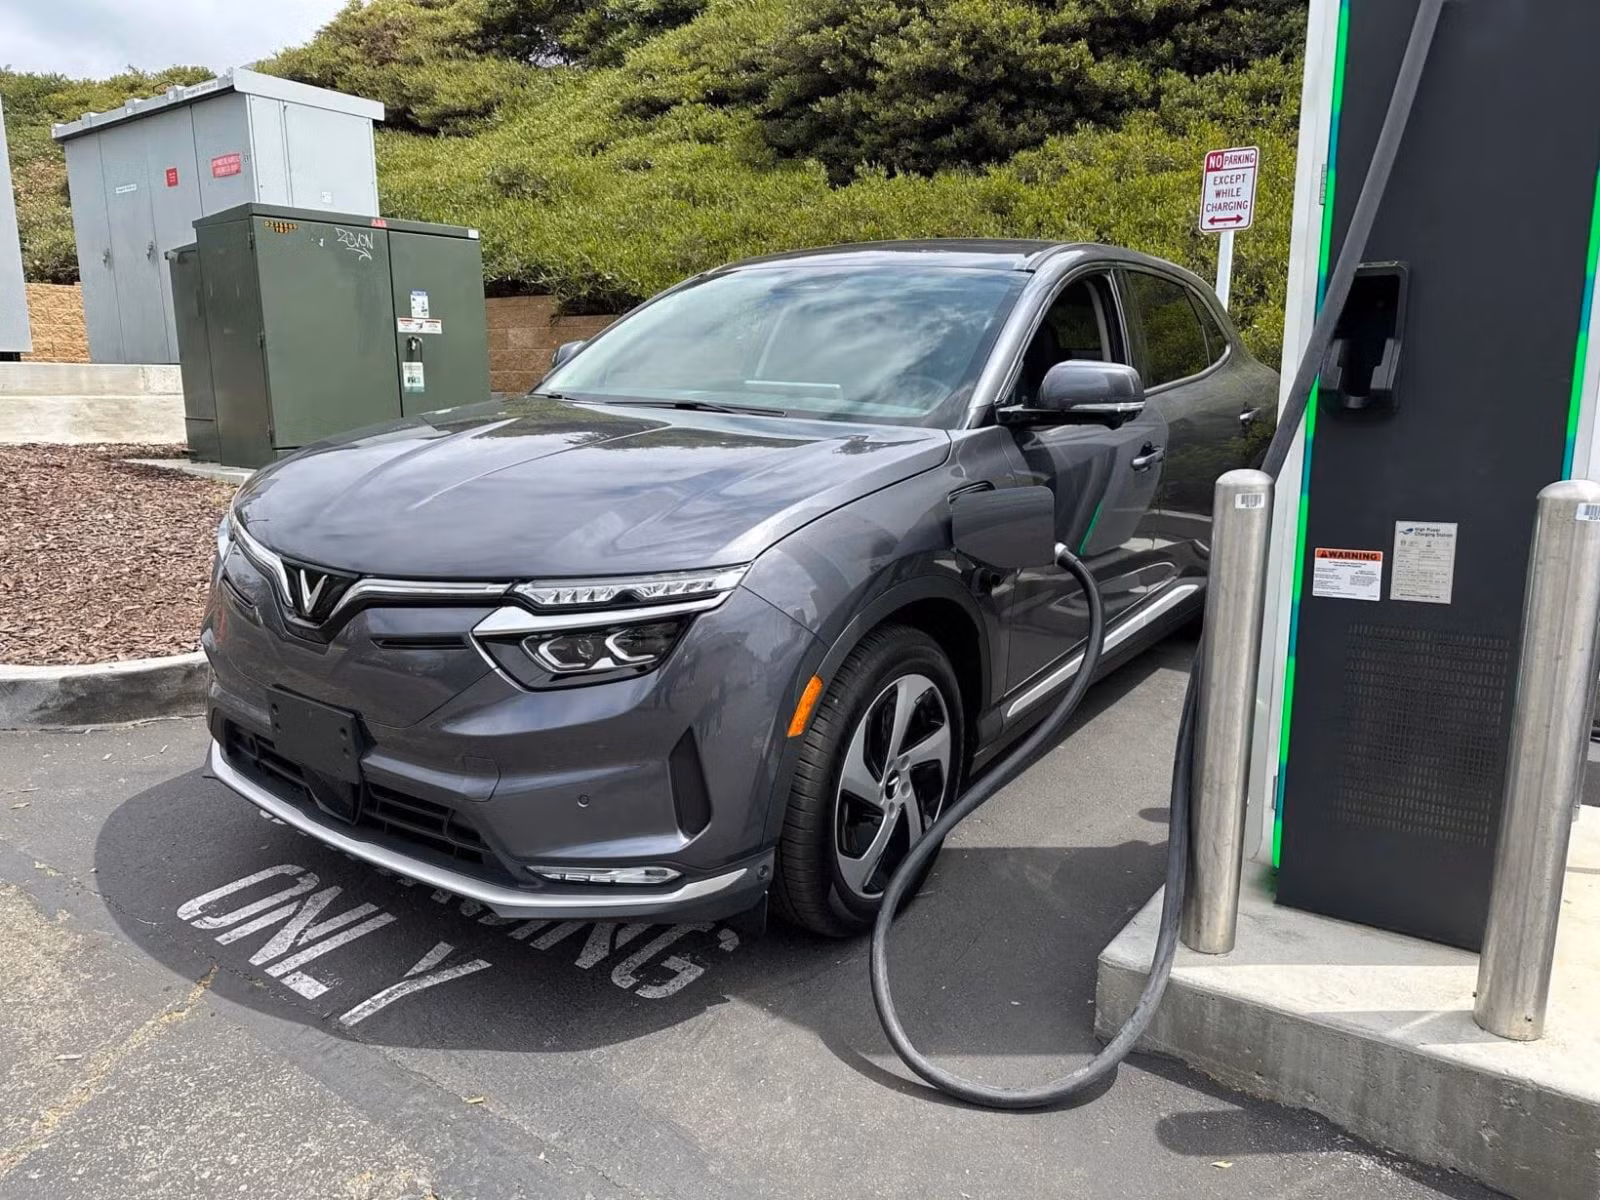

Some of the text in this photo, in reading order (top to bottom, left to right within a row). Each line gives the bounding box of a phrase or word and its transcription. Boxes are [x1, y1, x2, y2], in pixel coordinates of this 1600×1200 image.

[1209, 153, 1254, 169] NO PARKING
[1213, 174, 1246, 185] EXCEPT
[1215, 188, 1241, 198] WHILE
[1206, 201, 1248, 212] CHARGING
[1327, 550, 1378, 561] WARNING
[176, 863, 493, 1027] ONLY
